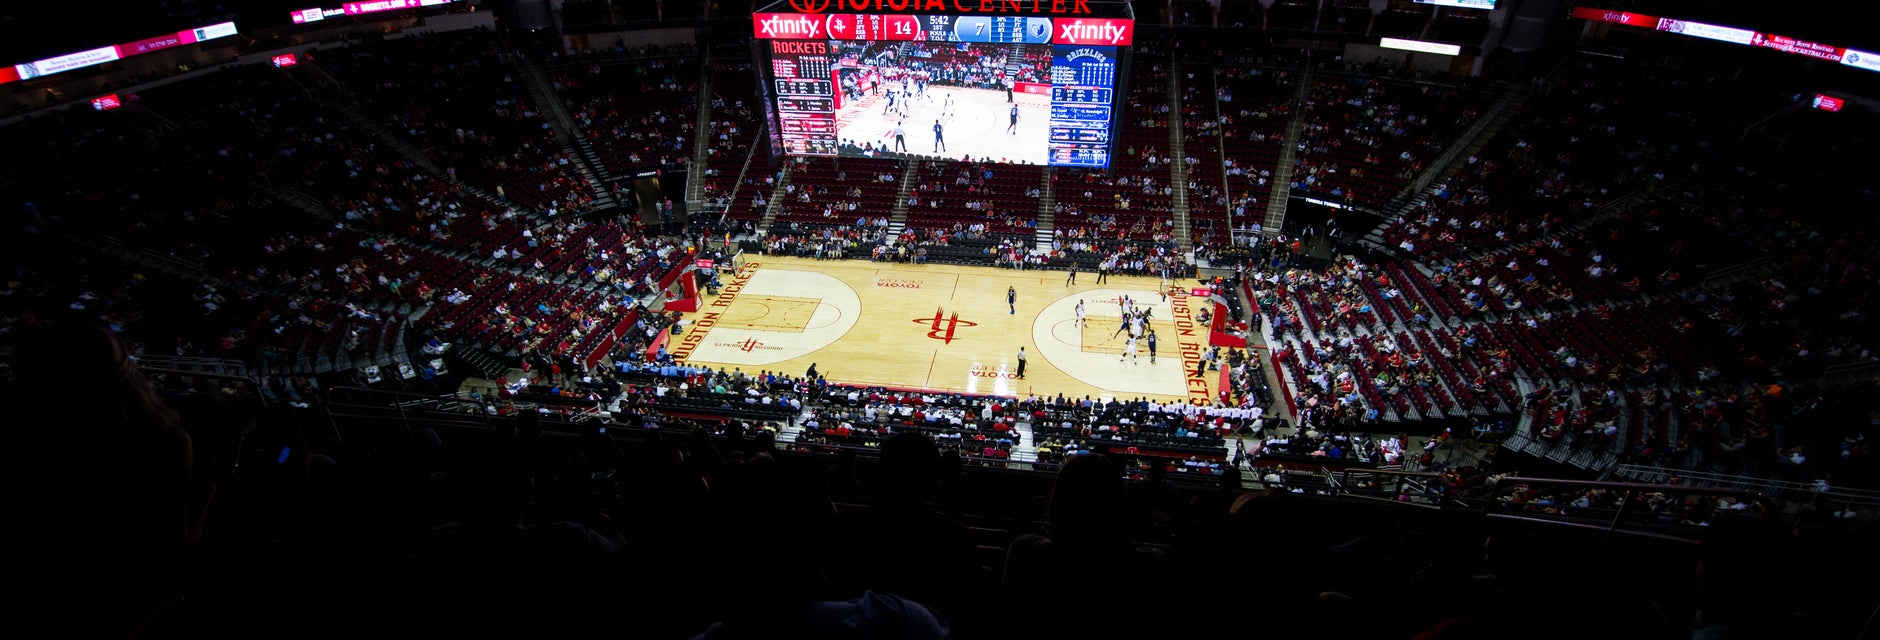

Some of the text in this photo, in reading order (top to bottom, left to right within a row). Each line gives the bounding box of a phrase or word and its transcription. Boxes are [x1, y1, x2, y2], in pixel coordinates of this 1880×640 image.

[930, 15, 949, 25] 5:42
[1603, 12, 1630, 23] xfinity
[894, 21, 911, 35] 14
[975, 22, 985, 36] 7
[772, 40, 826, 54] ROCKETS
[1066, 48, 1107, 63] GRIZZLIES
